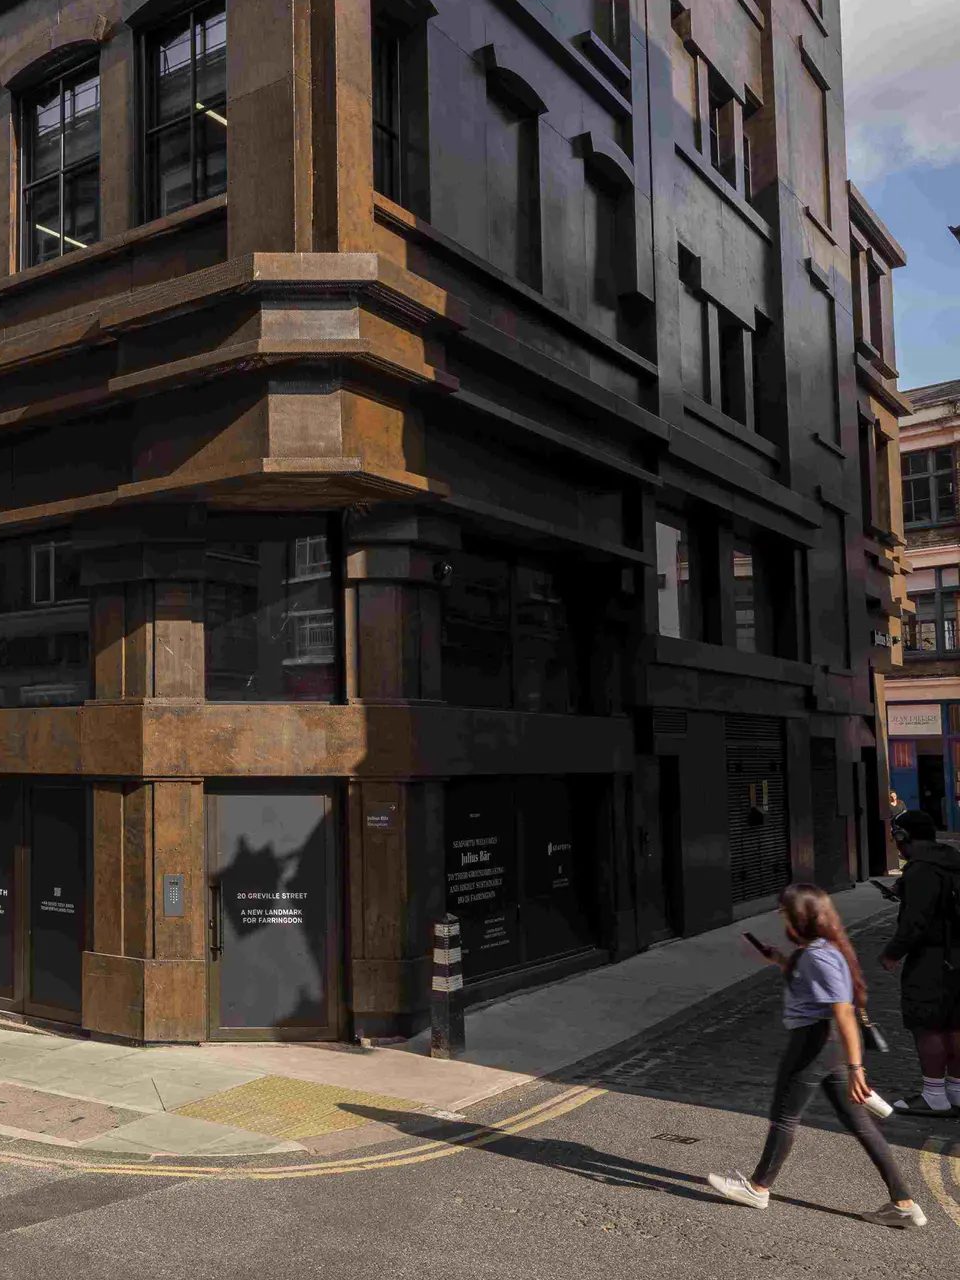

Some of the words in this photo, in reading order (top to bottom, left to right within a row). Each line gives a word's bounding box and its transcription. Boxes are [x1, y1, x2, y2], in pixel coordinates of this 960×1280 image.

[461, 852, 479, 866] Julius
[479, 850, 491, 862] Bär
[237, 892, 247, 900] 20
[247, 892, 280, 900] GREVILLE
[281, 892, 308, 900] STREET
